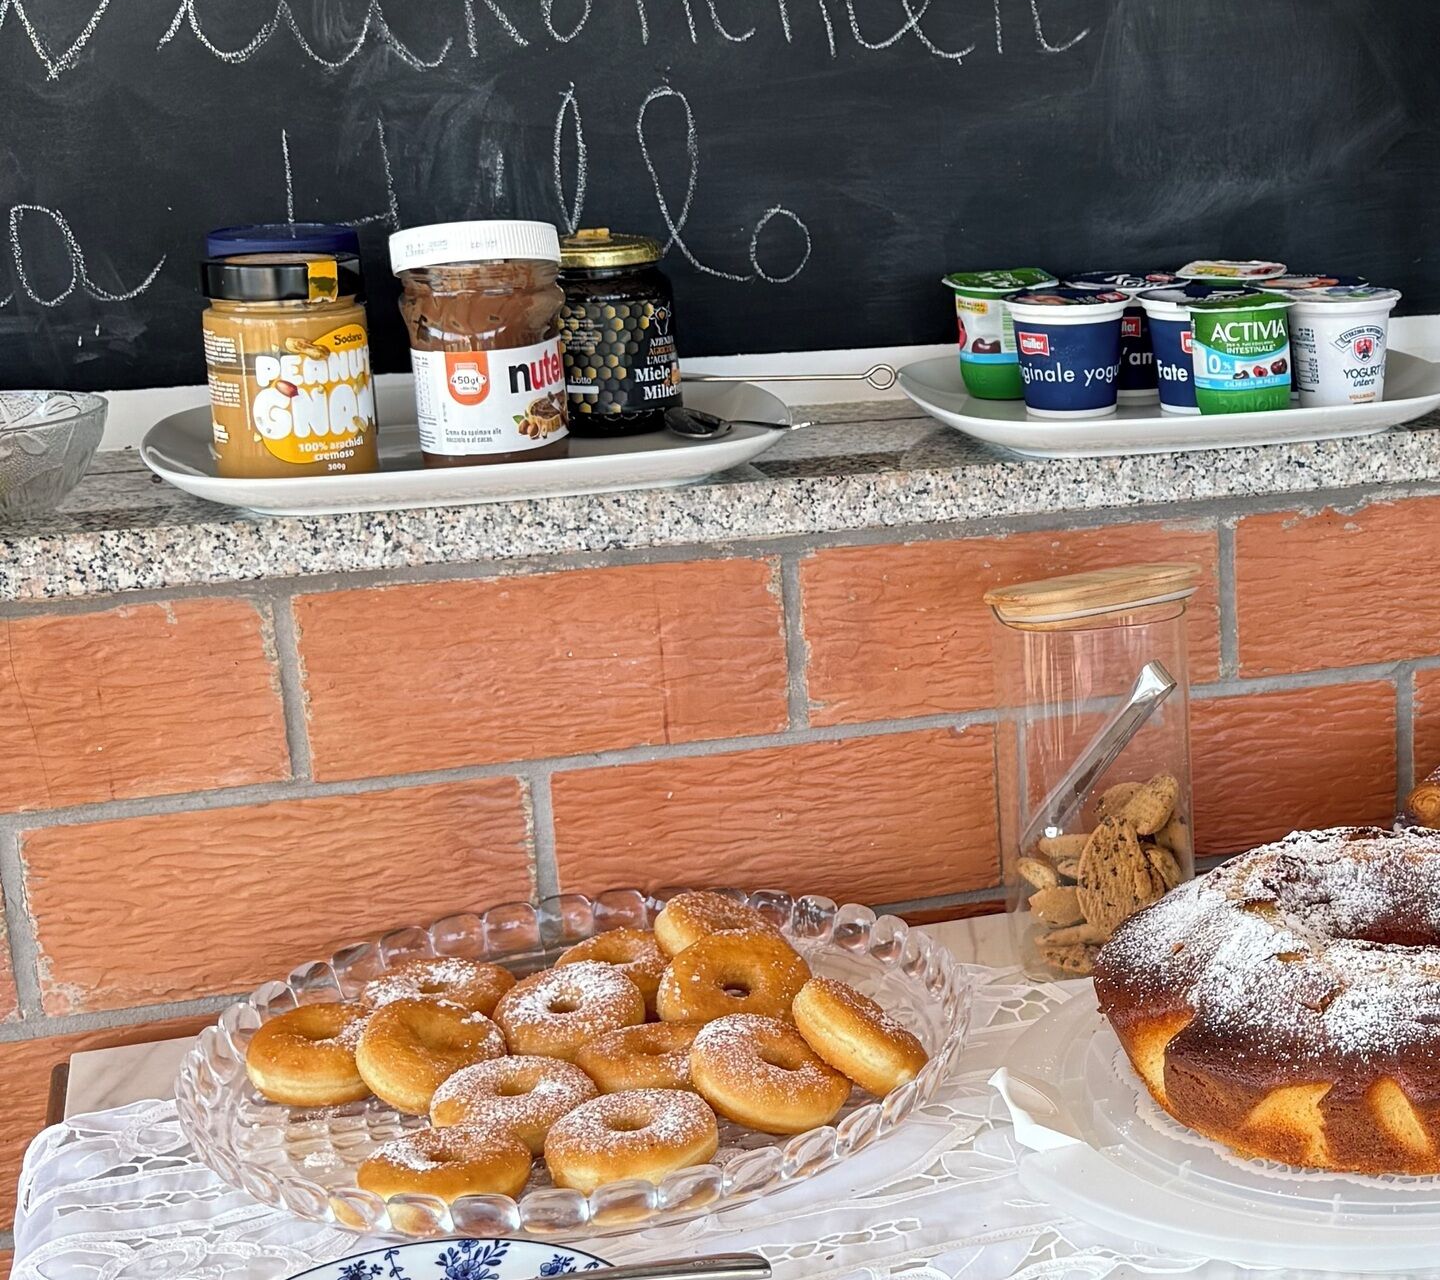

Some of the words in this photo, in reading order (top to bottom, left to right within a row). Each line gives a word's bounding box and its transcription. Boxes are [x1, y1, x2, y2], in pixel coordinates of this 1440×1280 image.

[1211, 319, 1286, 342] ACTIVIA
[255, 345, 370, 388] PEANUT
[508, 340, 564, 394] nutel
[634, 365, 671, 383] Miele
[1343, 364, 1381, 379] YOGURT
[570, 375, 592, 385] Lotto
[298, 443, 328, 453] 100%
[329, 438, 364, 451] arachidi
[314, 449, 355, 462] cremoso
[327, 463, 346, 471] 300g
